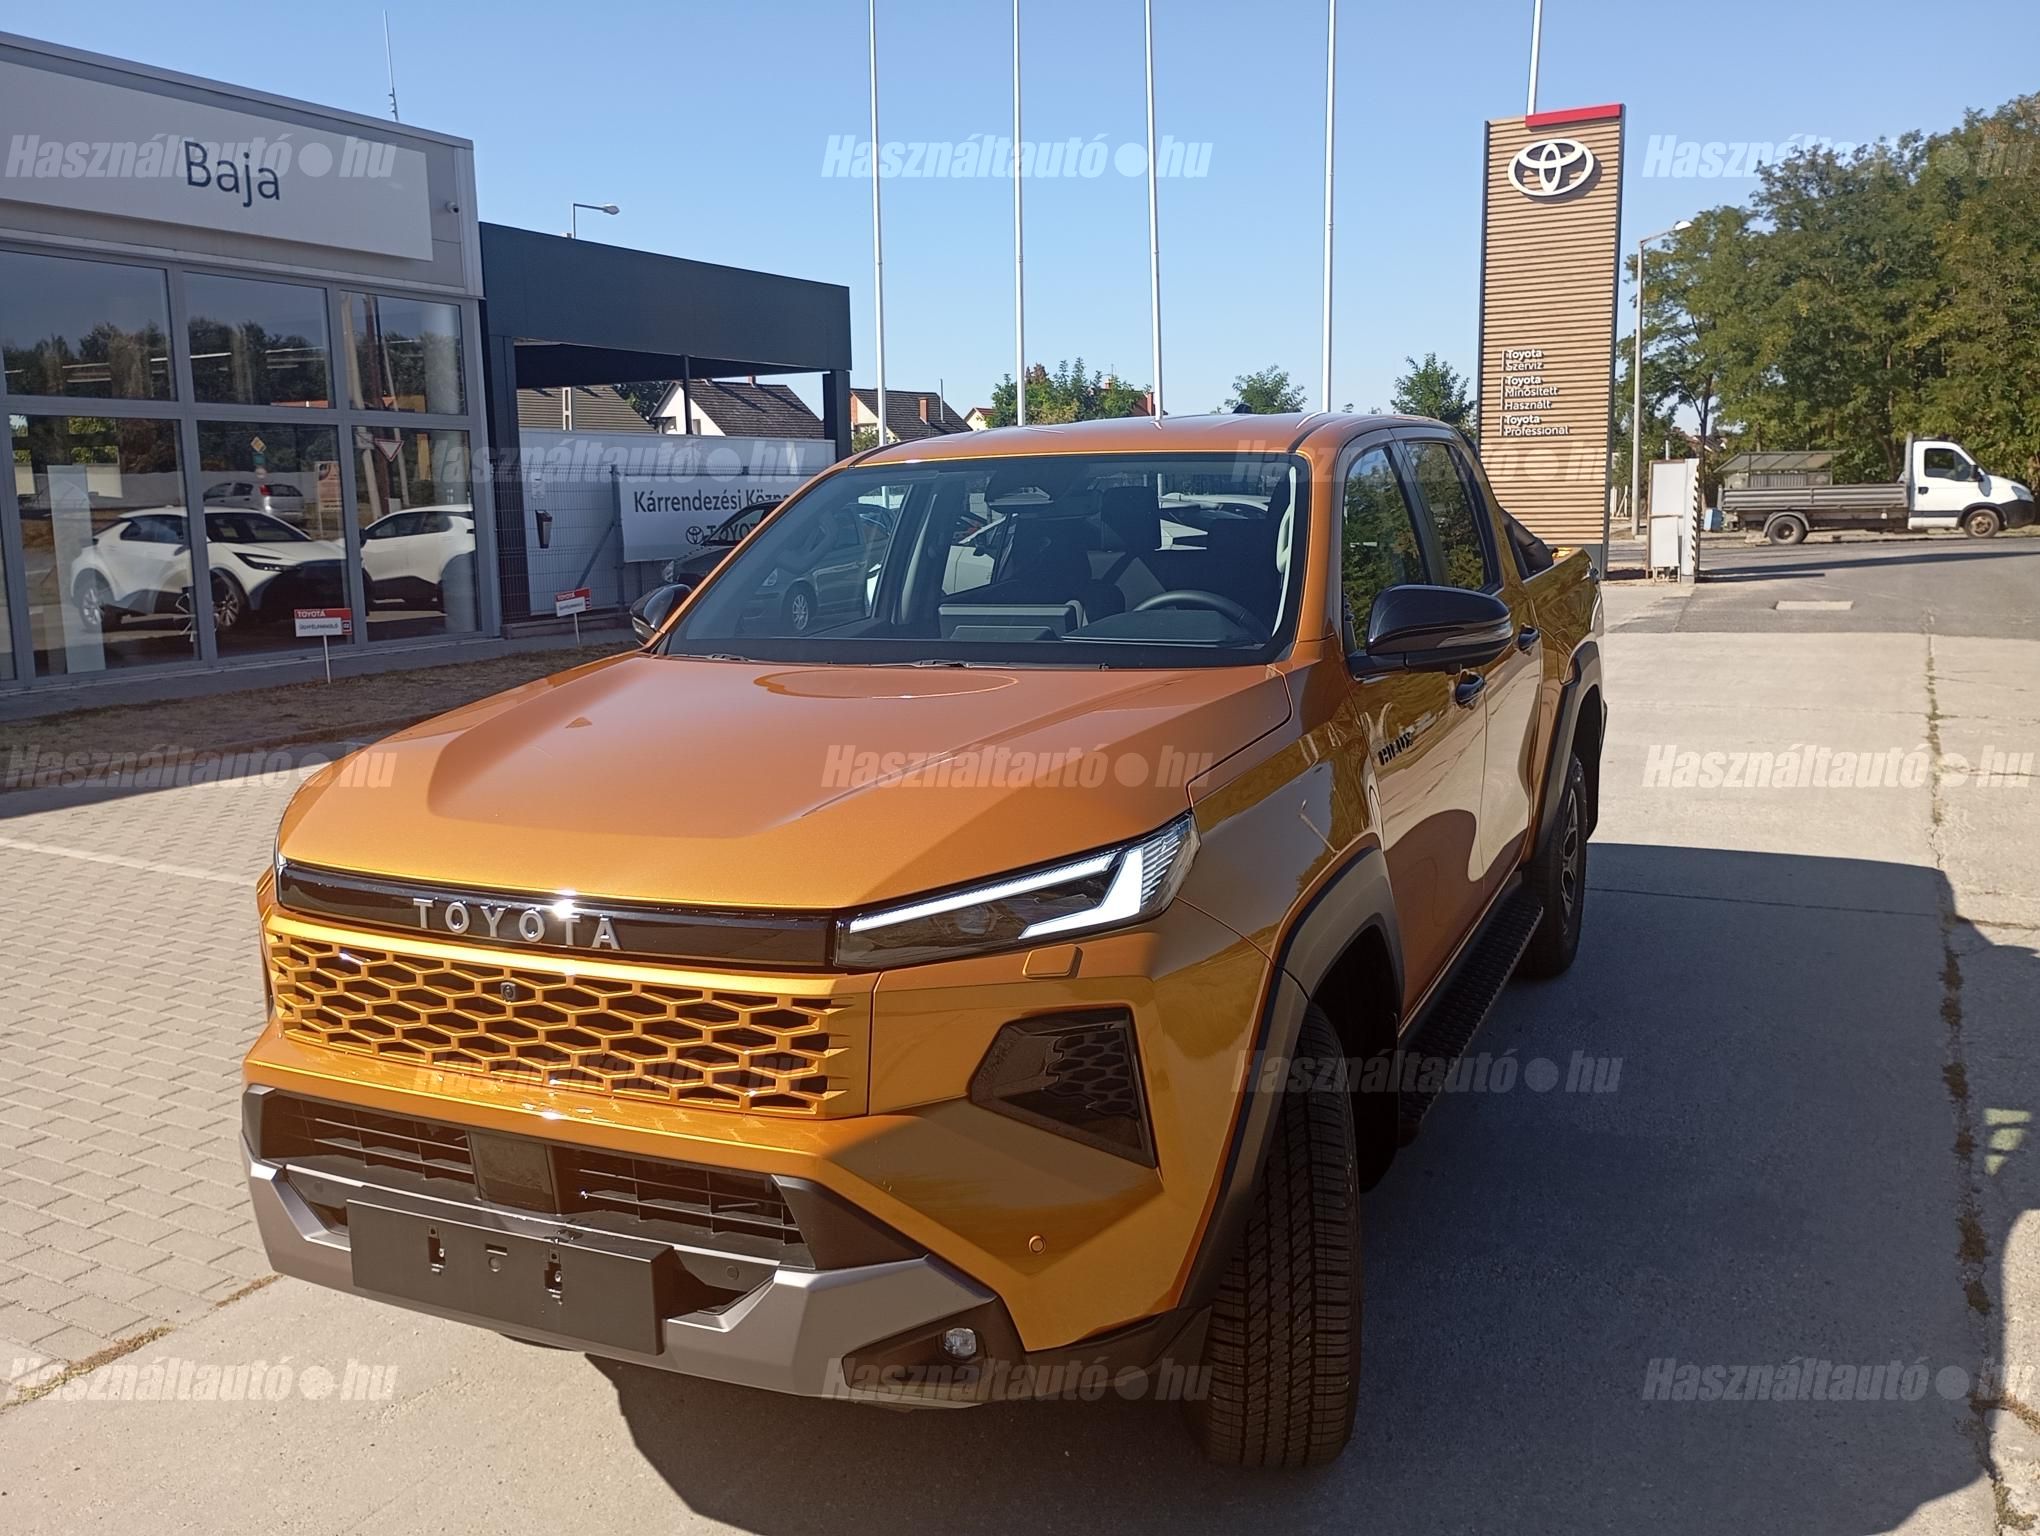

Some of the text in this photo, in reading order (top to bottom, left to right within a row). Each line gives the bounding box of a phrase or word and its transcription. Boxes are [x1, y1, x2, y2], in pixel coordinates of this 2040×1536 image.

[184, 141, 280, 207] Baja
[1506, 350, 1543, 363] Toyota
[1505, 361, 1544, 371] Szerviz
[1505, 375, 1542, 388] Toyota
[1504, 399, 1551, 410] Használt
[1504, 414, 1541, 427] Toyota
[1503, 426, 1569, 437] Professional
[634, 489, 742, 513] Kárrendezési
[297, 610, 326, 618] TOYOTA
[413, 898, 622, 951] TOYOTA
